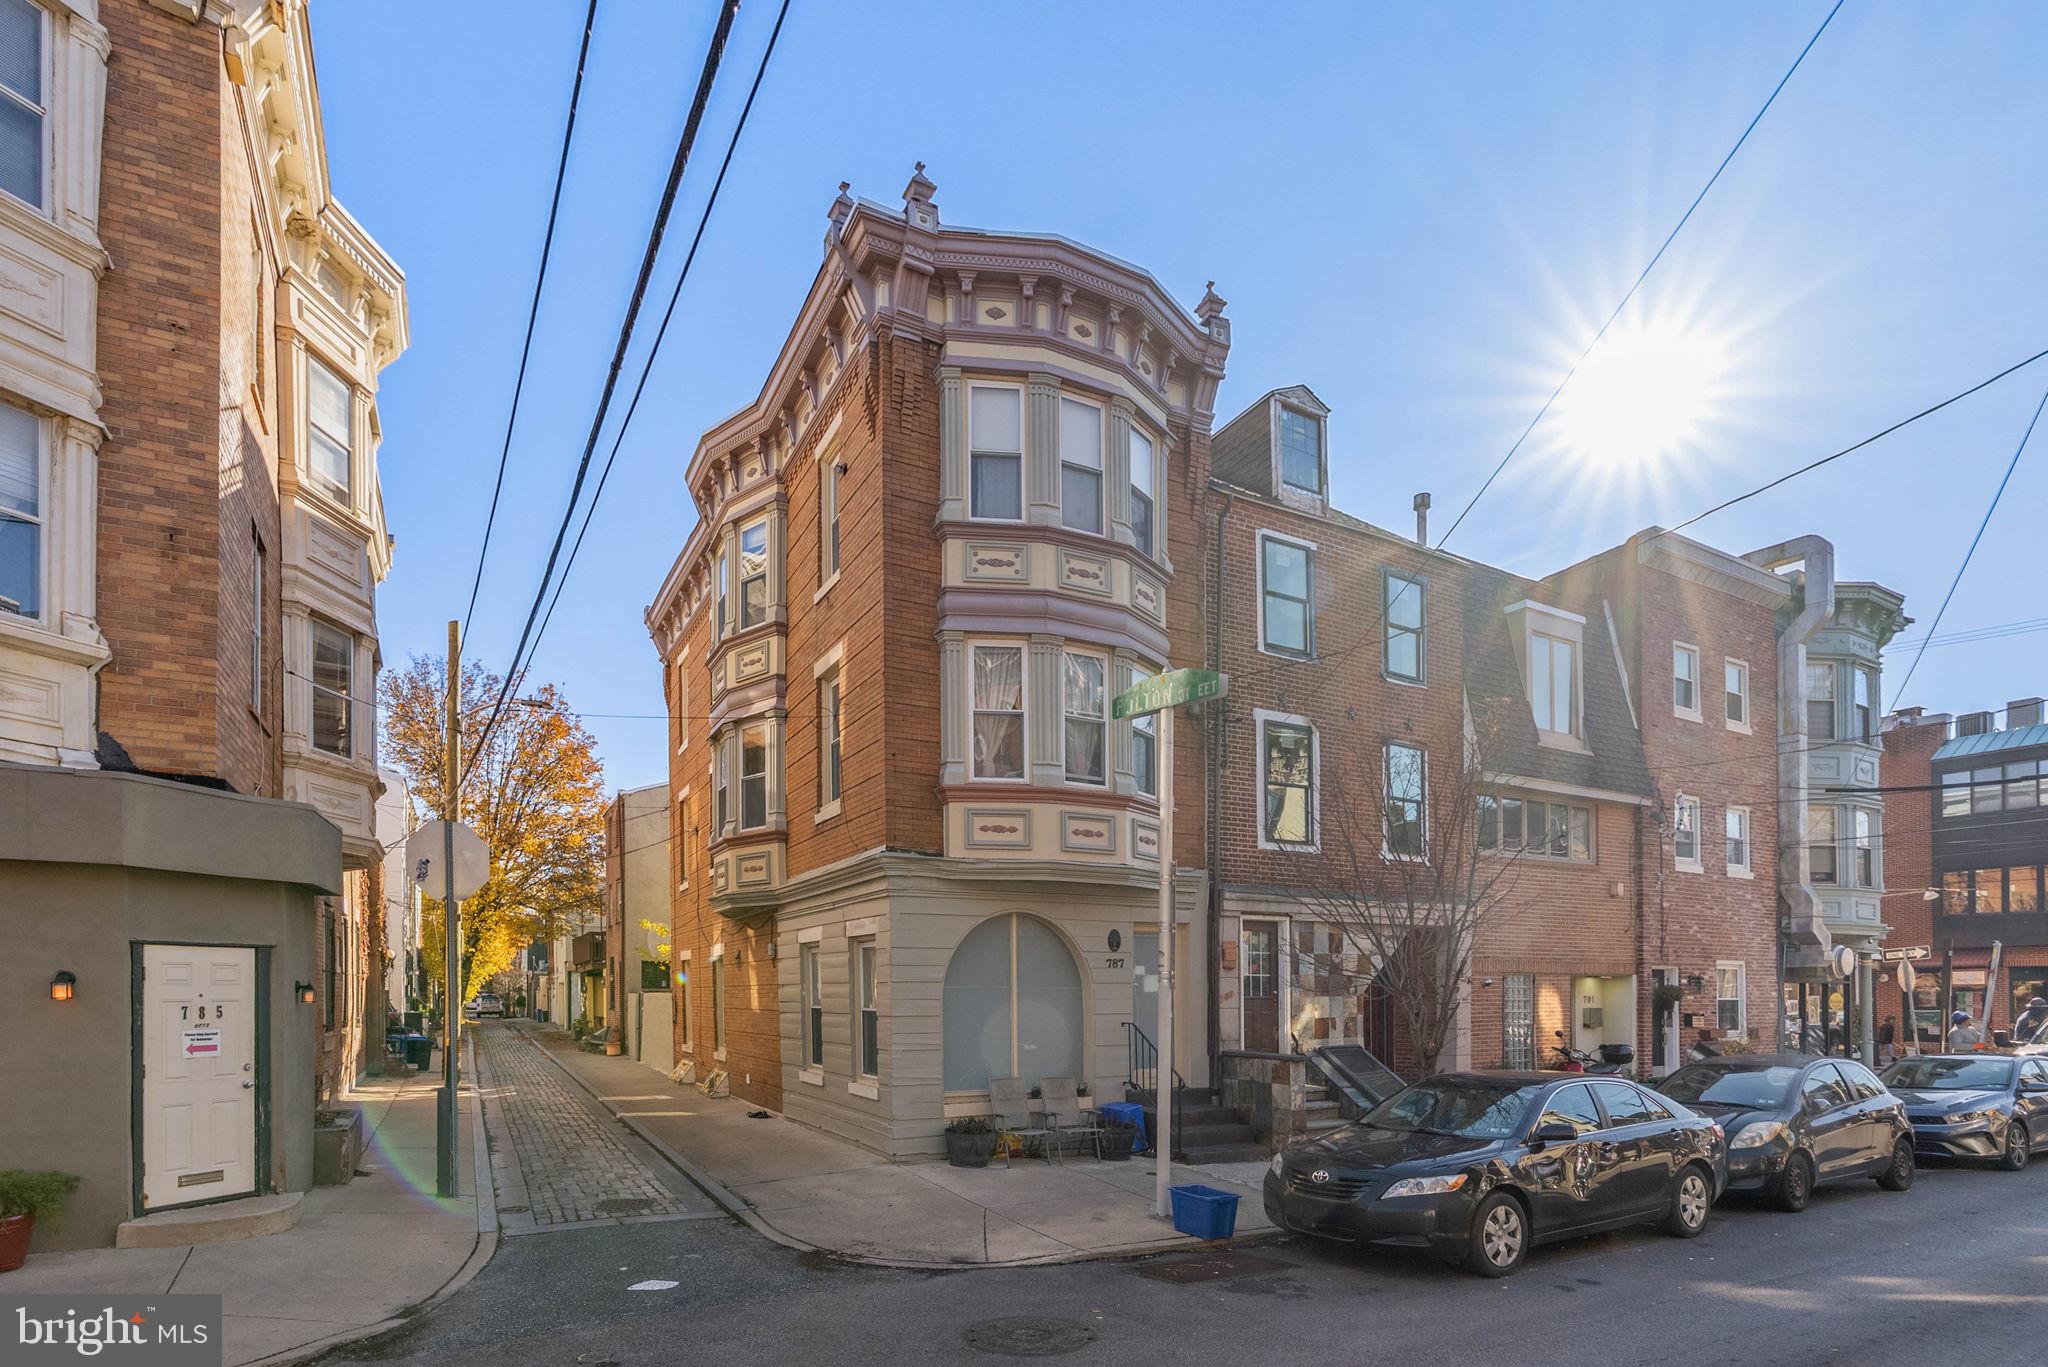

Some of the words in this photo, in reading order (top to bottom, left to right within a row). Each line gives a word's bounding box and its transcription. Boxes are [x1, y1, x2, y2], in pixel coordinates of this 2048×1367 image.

[1177, 680, 1216, 703] STEET
[1106, 958, 1124, 969] 787
[1583, 995, 1595, 1004] 791
